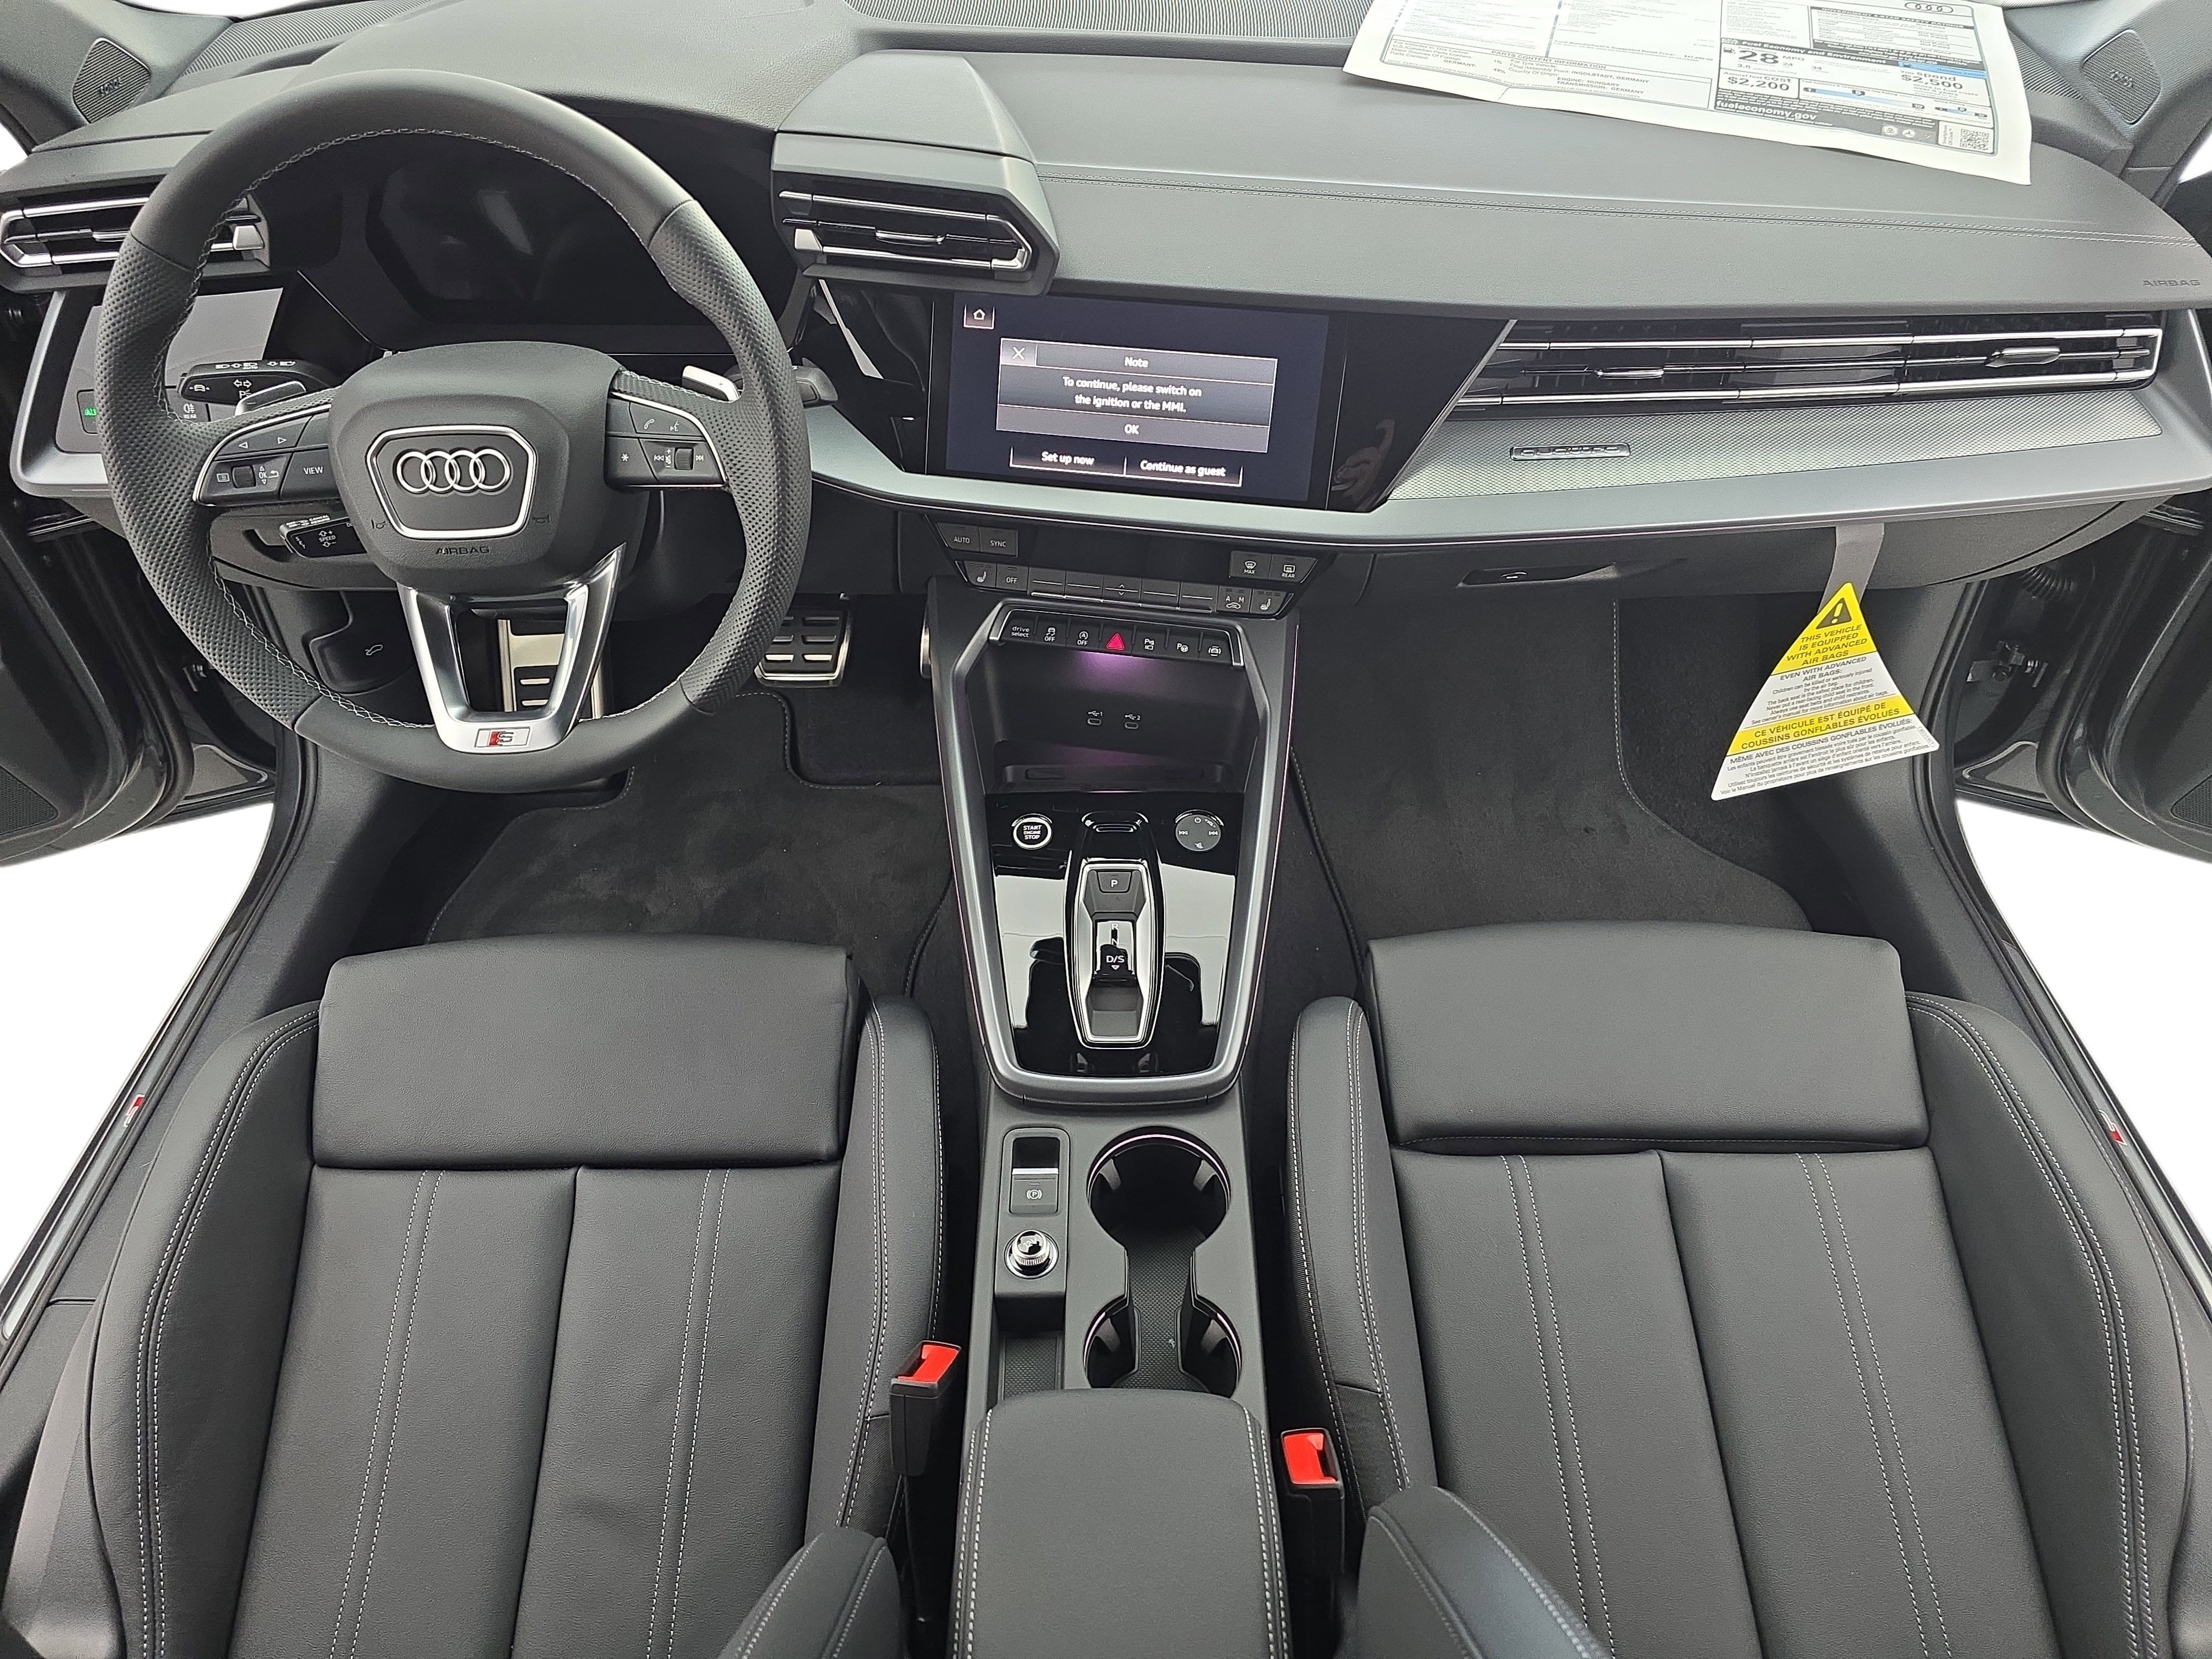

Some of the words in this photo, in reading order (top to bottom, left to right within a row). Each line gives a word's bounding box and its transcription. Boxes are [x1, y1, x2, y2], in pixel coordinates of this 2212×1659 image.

[1739, 49, 1778, 64] 28
[1763, 43, 1805, 54] Economy
[1827, 52, 1886, 63] Environment
[1518, 54, 1551, 62] CONTENT
[1555, 59, 1605, 69] INFORMATION
[1556, 80, 1607, 90] TRANSMISSION:
[1727, 76, 1789, 91] $2,200
[1901, 74, 1963, 89] $2,500
[1716, 100, 1816, 121] fueleconomy.gov
[1124, 357, 1149, 368] Note
[1063, 376, 1074, 387] To
[1076, 380, 1120, 391] continue,
[1122, 382, 1154, 393] please
[1155, 385, 1187, 396] switch
[1188, 389, 1202, 397] on
[1075, 394, 1091, 404] the
[1093, 396, 1129, 408] ignition
[1131, 400, 1142, 408] or
[1144, 400, 1160, 410] the
[1162, 401, 1187, 413] MMI.
[1124, 424, 1139, 435] OK
[1041, 451, 1058, 462] Set
[1059, 454, 1072, 465] up
[1073, 456, 1095, 465] now
[259, 471, 268, 479] OK
[303, 466, 323, 475] VIEW
[1140, 460, 1184, 473] Continue
[1185, 465, 1196, 474] as
[1197, 466, 1226, 477] guest
[435, 546, 490, 555] AIRBAG
[1801, 633, 1821, 642] THIS
[1823, 624, 1861, 638] VEHICLE
[1812, 633, 1858, 647] EQUIPPED
[1787, 650, 1811, 661] WITH
[1814, 638, 1867, 655] ADVANCED
[1801, 657, 1818, 665] AIR
[1822, 650, 1849, 661] BAGS
[1780, 671, 1800, 680] EVEN
[1802, 666, 1822, 675] WITH
[1824, 657, 1866, 670] ADVANCED
[1818, 668, 1842, 678] BAGS:
[1769, 717, 1814, 734] VÉHICULE
[1817, 714, 1835, 723] EST
[1838, 704, 1870, 718] ÉQUIPÉ
[1741, 733, 1790, 749] COUSSINS
[1793, 718, 1854, 737] GONFLABLES
[1858, 707, 1899, 723] ÉVOLUÉS
[1730, 753, 1753, 763] MÊME
[1755, 749, 1774, 758] AVEC
[1791, 737, 1828, 750] COUSSINS
[1830, 726, 1876, 741] GONFLABLES
[1879, 717, 1912, 730] ÉVOLUÉS:
[1111, 879, 1118, 888] P
